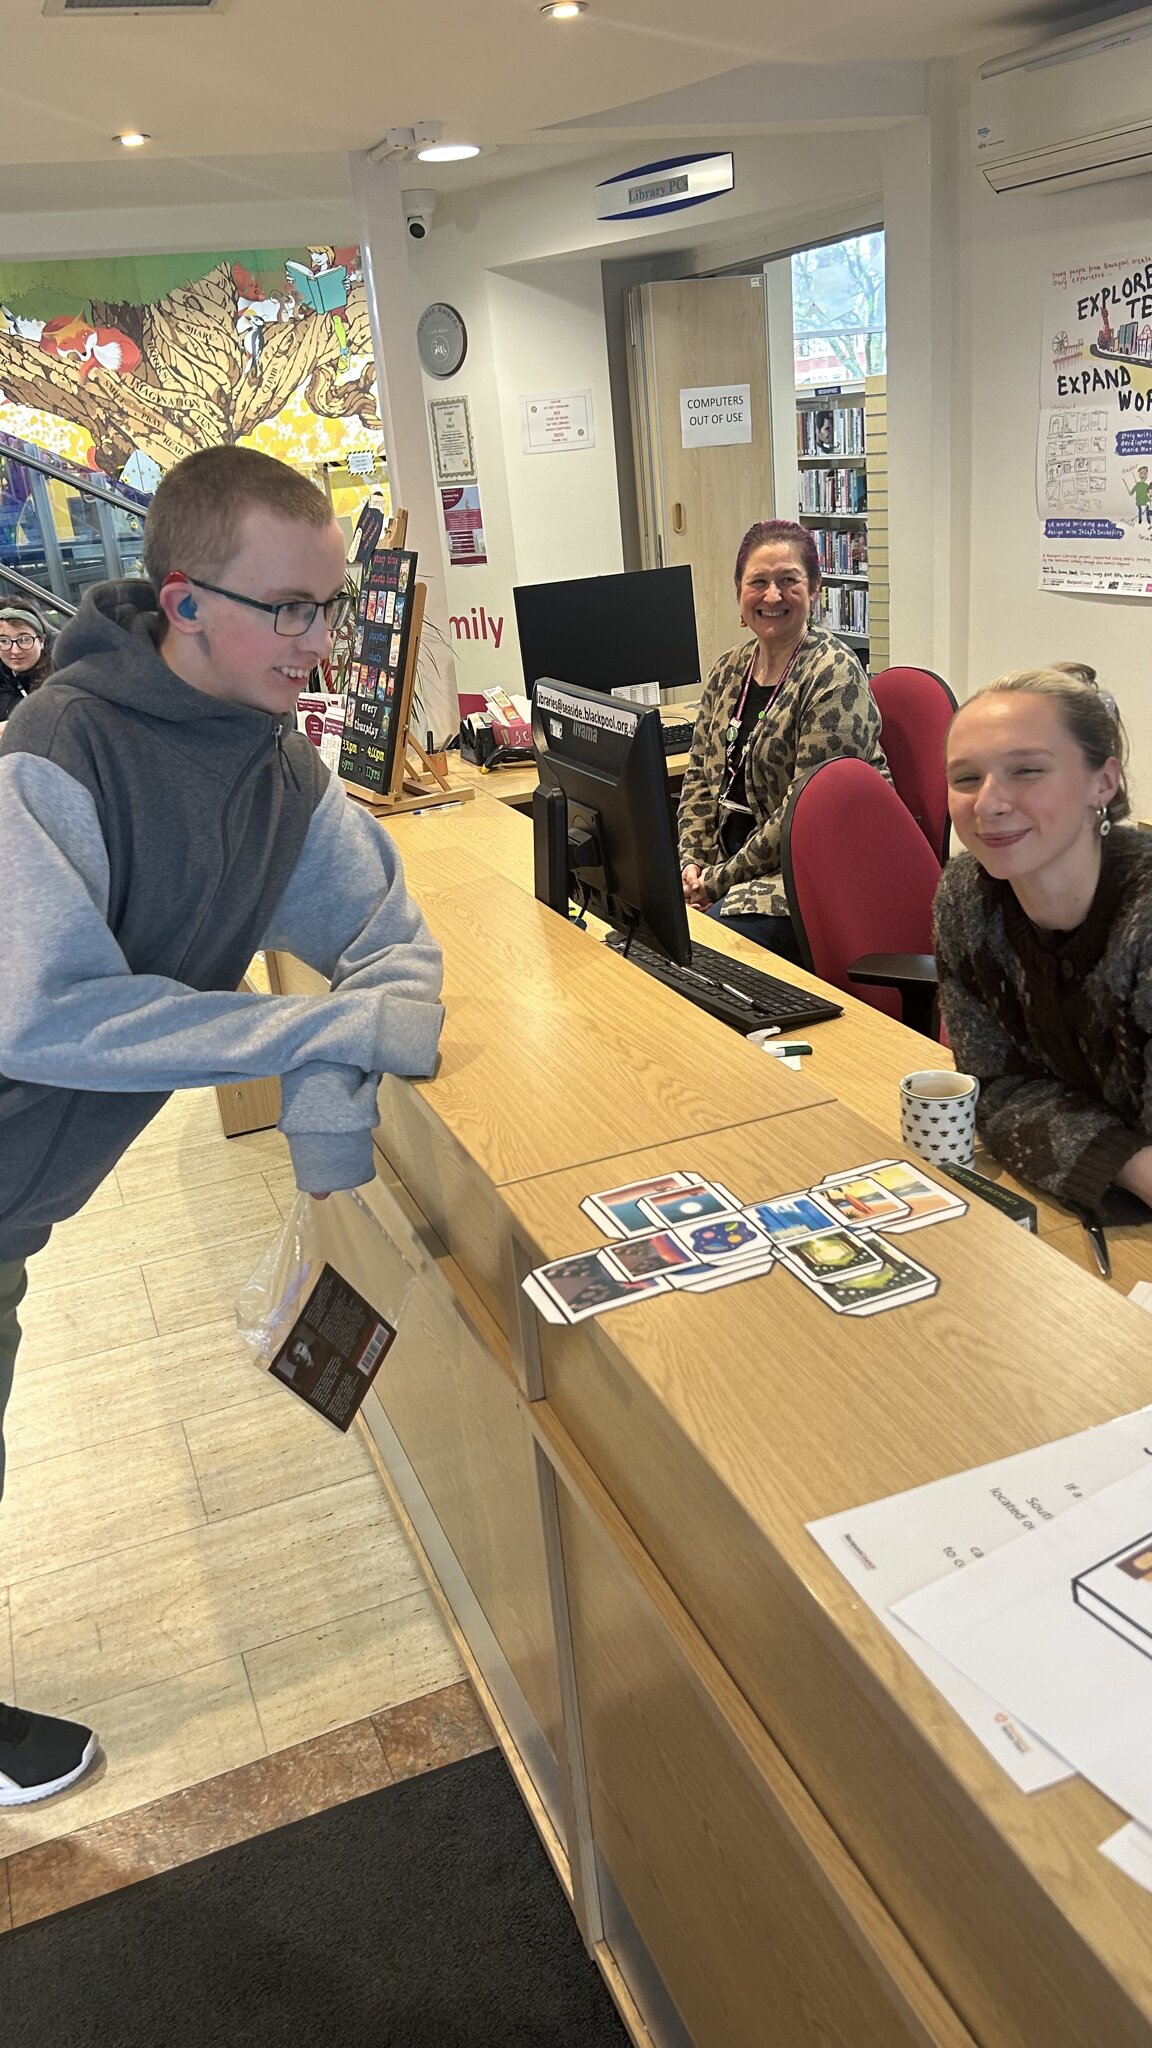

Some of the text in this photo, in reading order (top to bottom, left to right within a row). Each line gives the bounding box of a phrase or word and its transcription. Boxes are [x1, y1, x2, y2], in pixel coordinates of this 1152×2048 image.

[629, 178, 689, 202] Library PCs
[1077, 263, 1152, 320] EXPLORE
[1126, 294, 1152, 320] TE
[186, 325, 215, 342] SHARE
[262, 367, 278, 395] CLIMB
[1057, 366, 1131, 396] EXPAND
[132, 378, 200, 410] IMAGINATION
[687, 395, 744, 409] COMPUTERS
[196, 415, 213, 430] FUN
[689, 412, 743, 426] OUT OF USE
[162, 436, 185, 457] READ
[1121, 440, 1152, 448] developme
[449, 607, 504, 648] mily
[361, 702, 378, 718] every
[989, 1487, 1027, 1521] located
[943, 1546, 956, 1558] to
